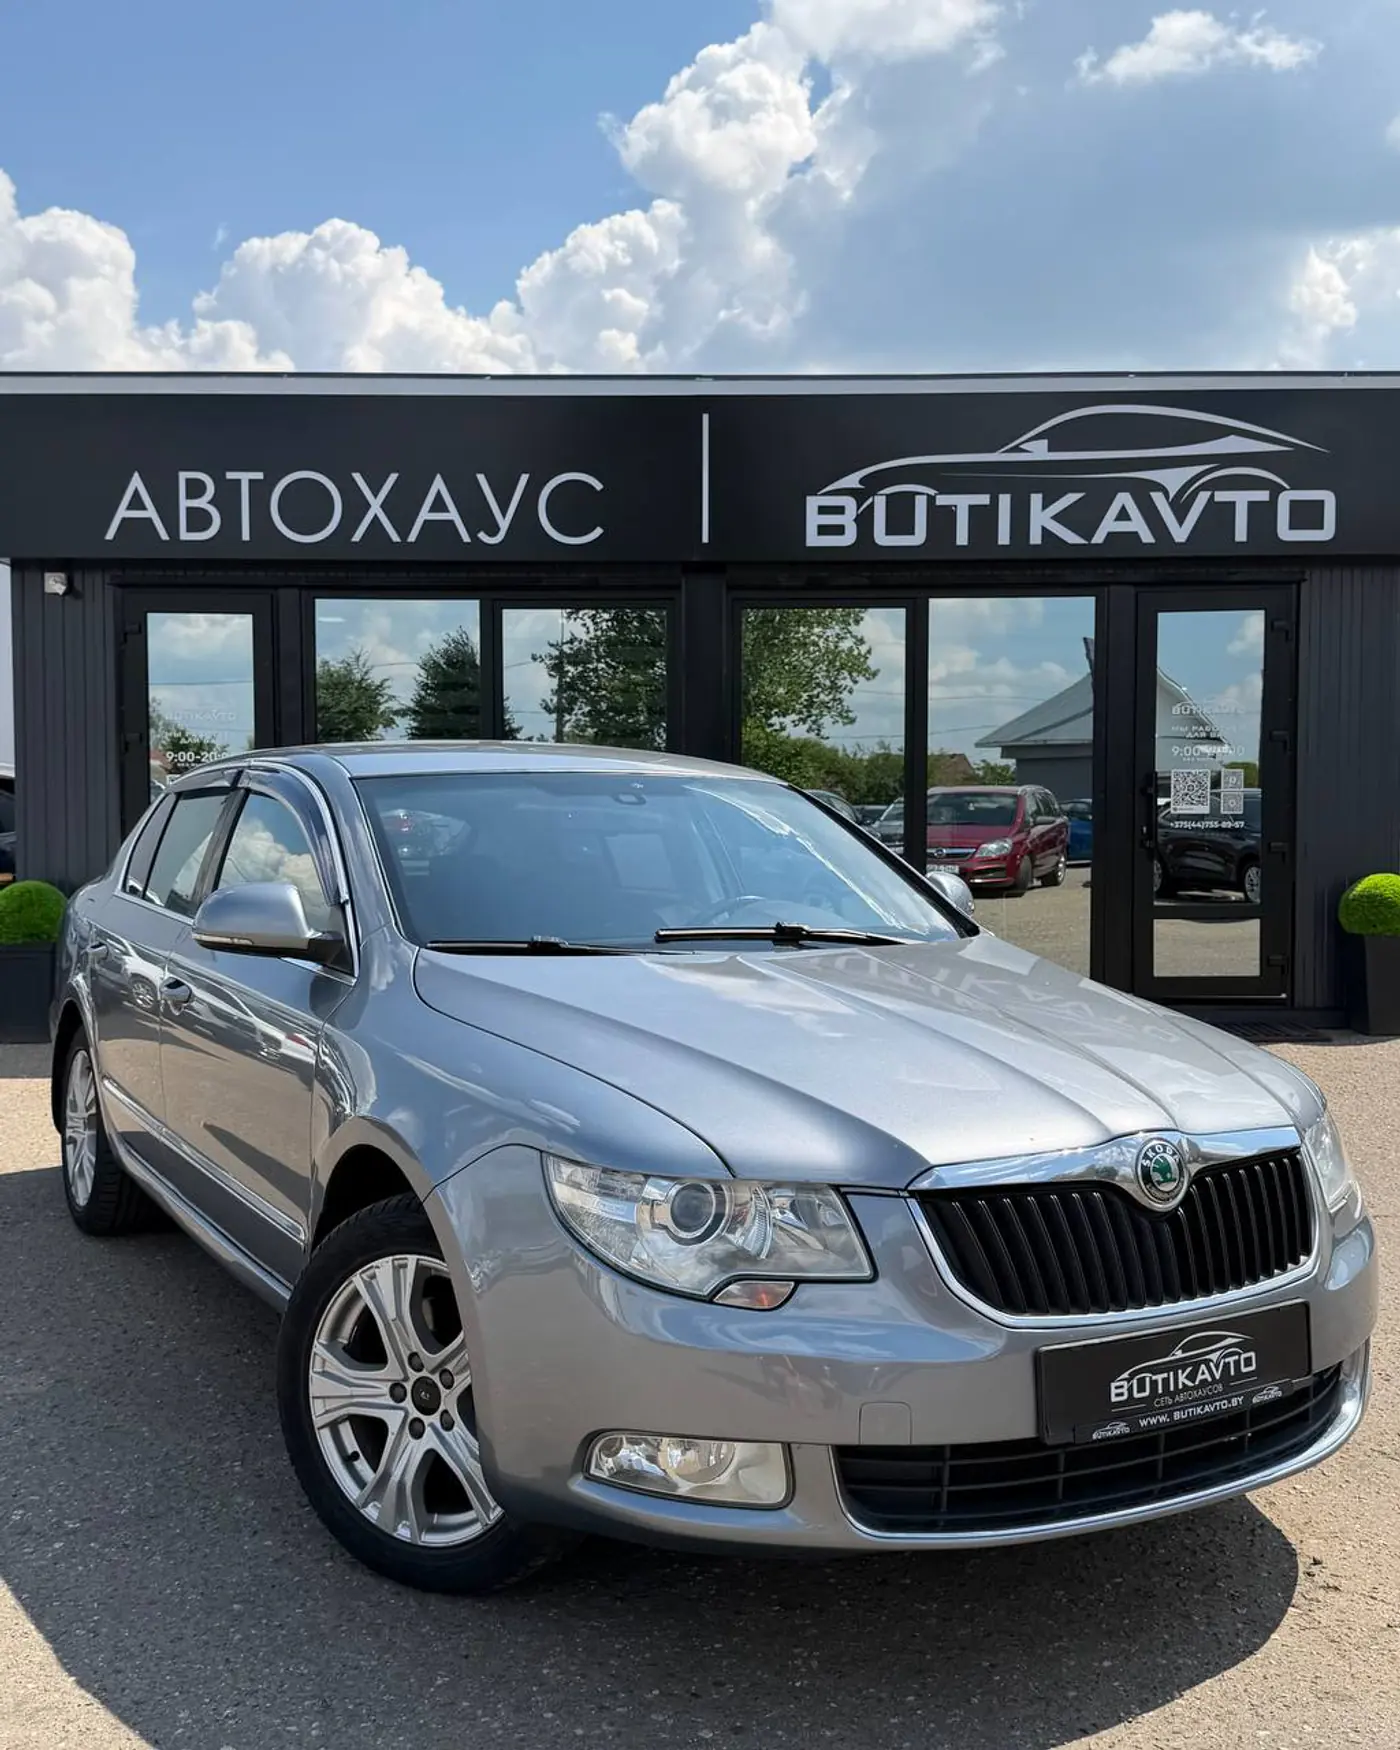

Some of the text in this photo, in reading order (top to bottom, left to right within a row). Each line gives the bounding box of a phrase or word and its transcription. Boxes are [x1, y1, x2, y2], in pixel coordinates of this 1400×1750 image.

[104, 470, 605, 546] АВТОХАУС
[804, 488, 1337, 548] BUTIKAVTO
[1110, 1351, 1257, 1402] BUTIKAVTO
[1153, 1396, 1174, 1408] СЕТЬ
[1138, 1413, 1170, 1428] WWW.
